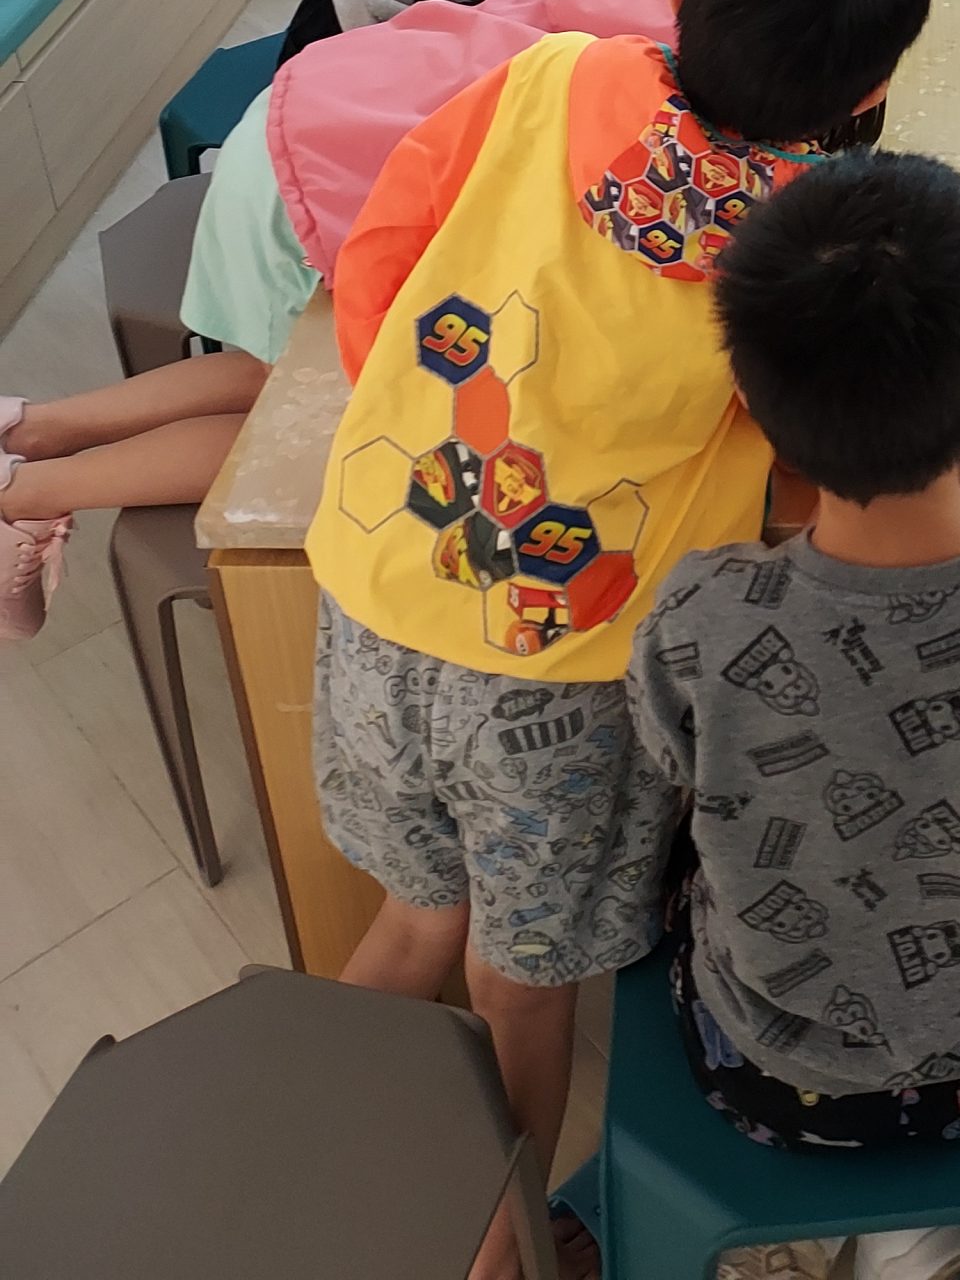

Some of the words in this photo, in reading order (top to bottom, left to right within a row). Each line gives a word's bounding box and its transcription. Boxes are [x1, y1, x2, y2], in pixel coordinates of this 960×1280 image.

[639, 229, 683, 259] 95
[422, 312, 489, 366] 95
[518, 520, 593, 564] 95
